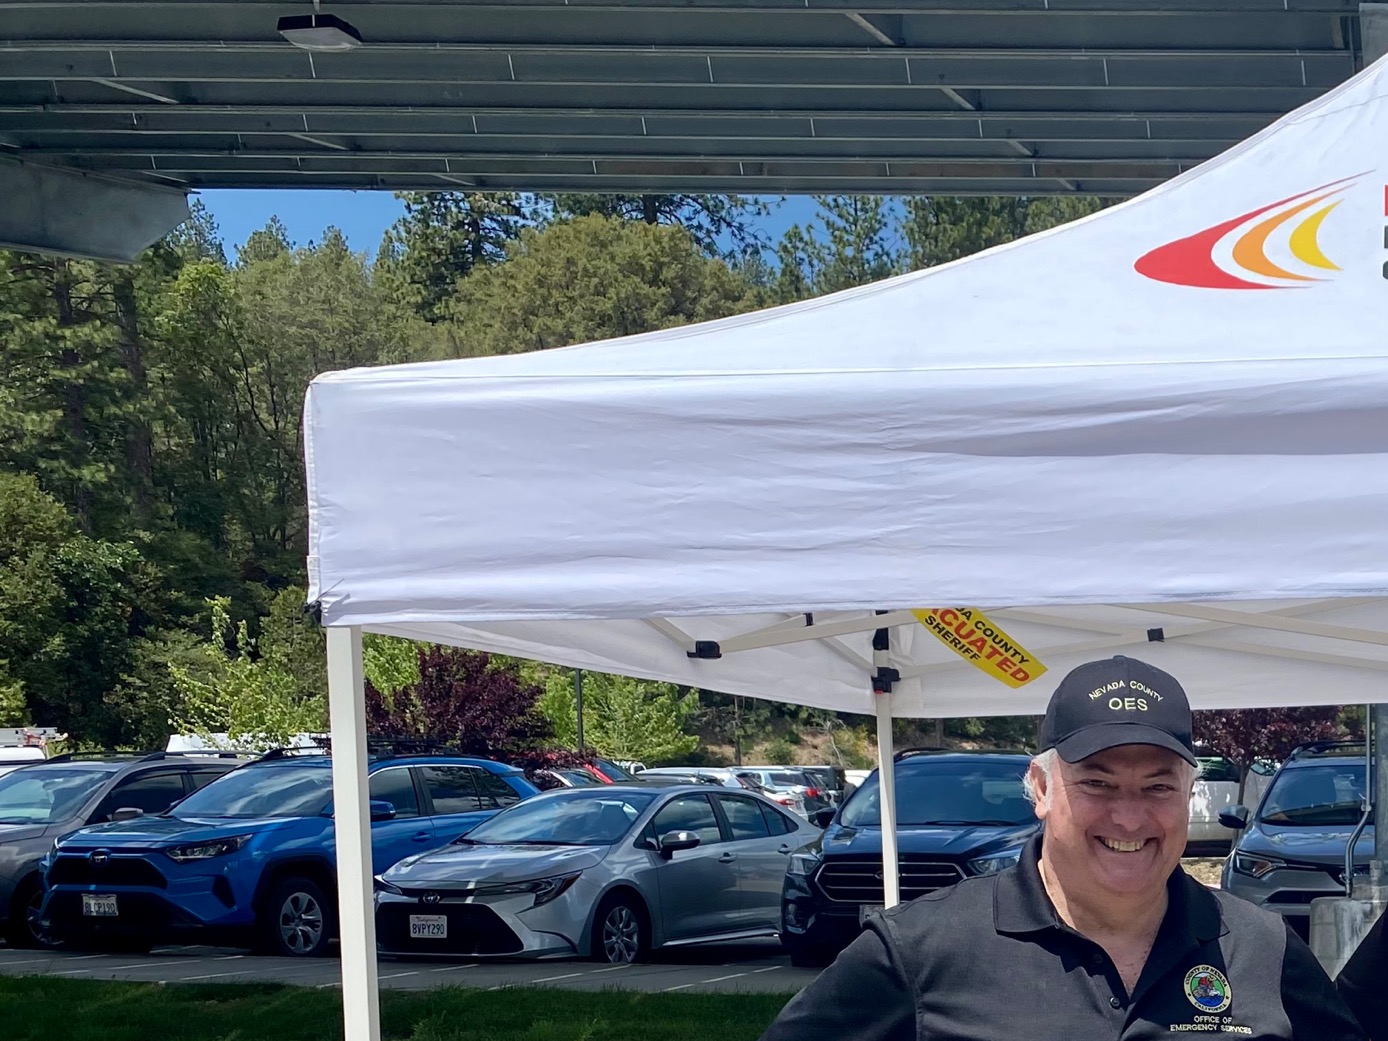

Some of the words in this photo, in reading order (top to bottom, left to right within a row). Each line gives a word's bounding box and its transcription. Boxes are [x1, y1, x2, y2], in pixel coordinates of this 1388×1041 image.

[925, 615, 981, 661] SHERIFF
[931, 608, 1030, 683] CUATED
[974, 620, 1030, 665] COUNTY
[1088, 680, 1126, 701] NEVADA
[1129, 680, 1165, 702] COUNTY
[1108, 697, 1148, 711] OES
[412, 923, 445, 935] 8VPY290
[1194, 1015, 1220, 1023] OFFICE
[1170, 1024, 1217, 1032] EMERGENCY
[1220, 1025, 1252, 1034] SERVICES
